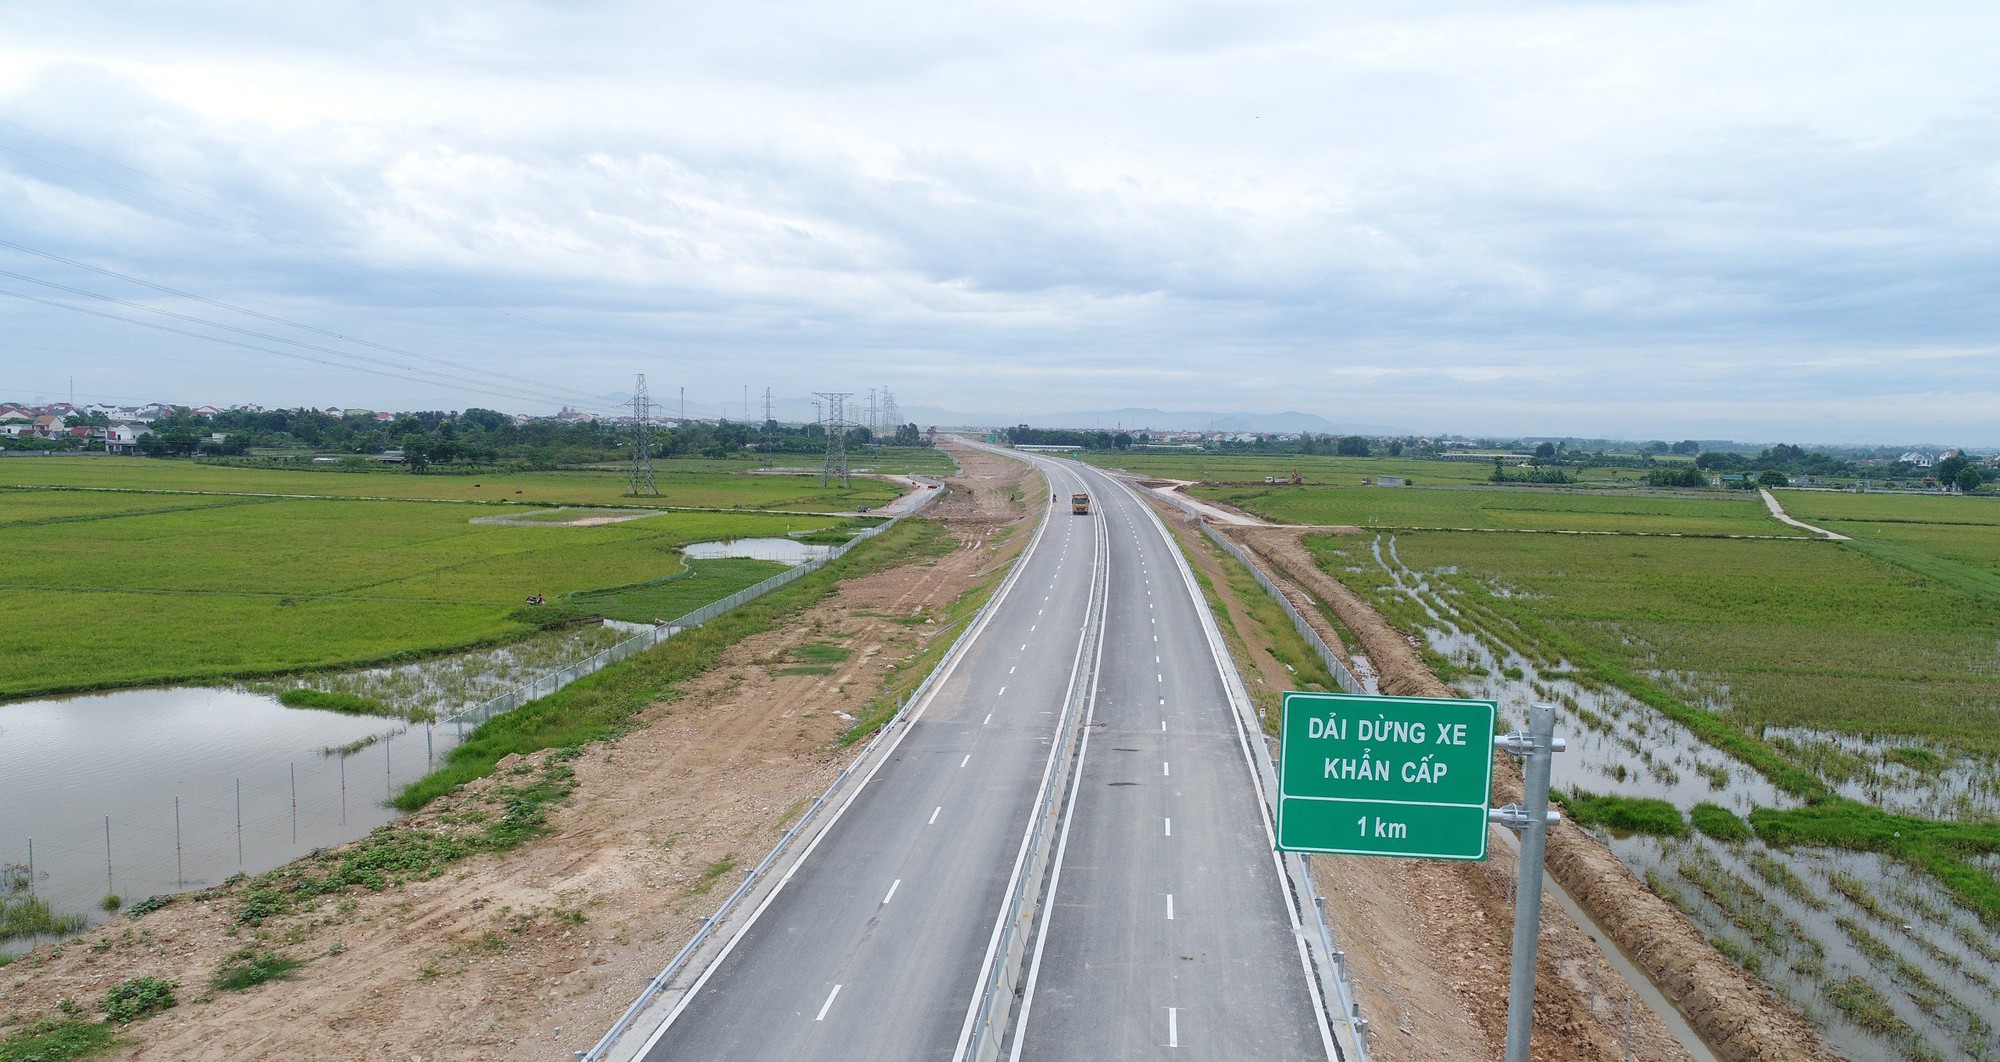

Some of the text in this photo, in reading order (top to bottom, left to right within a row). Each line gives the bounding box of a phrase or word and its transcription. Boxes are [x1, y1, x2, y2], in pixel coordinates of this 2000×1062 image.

[1308, 712, 1467, 746] DẢI DỪNG XE
[1324, 747, 1448, 784] KHẨN CẤP
[1357, 816, 1407, 839] 1 km
